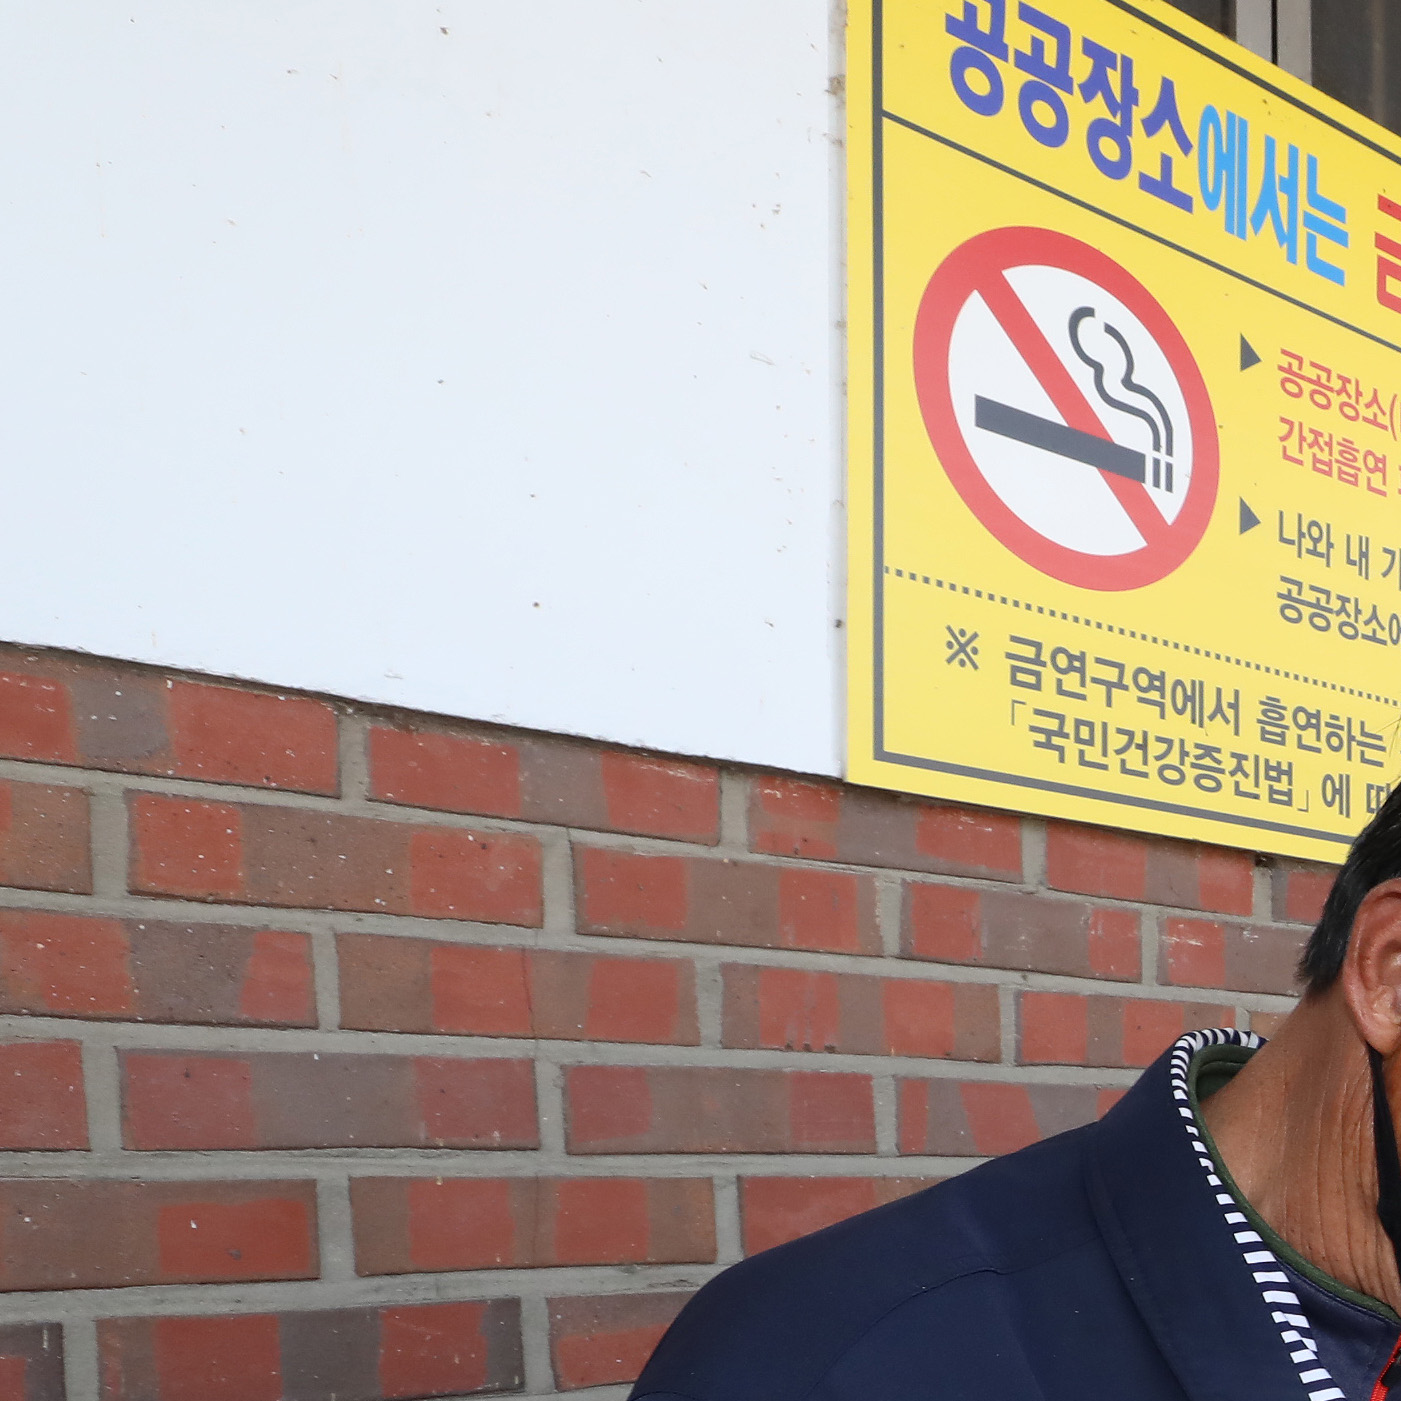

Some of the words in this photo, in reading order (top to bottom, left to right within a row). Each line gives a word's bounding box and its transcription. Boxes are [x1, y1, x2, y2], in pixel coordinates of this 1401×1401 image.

[944, 0, 1349, 286] 공공장소에서는
[1277, 415, 1389, 499] 간접흡연
[1277, 509, 1335, 569] 나와
[1344, 532, 1371, 581] 내
[1004, 634, 1241, 736] 금연구역에서
[1256, 695, 1389, 768] 흡연하는
